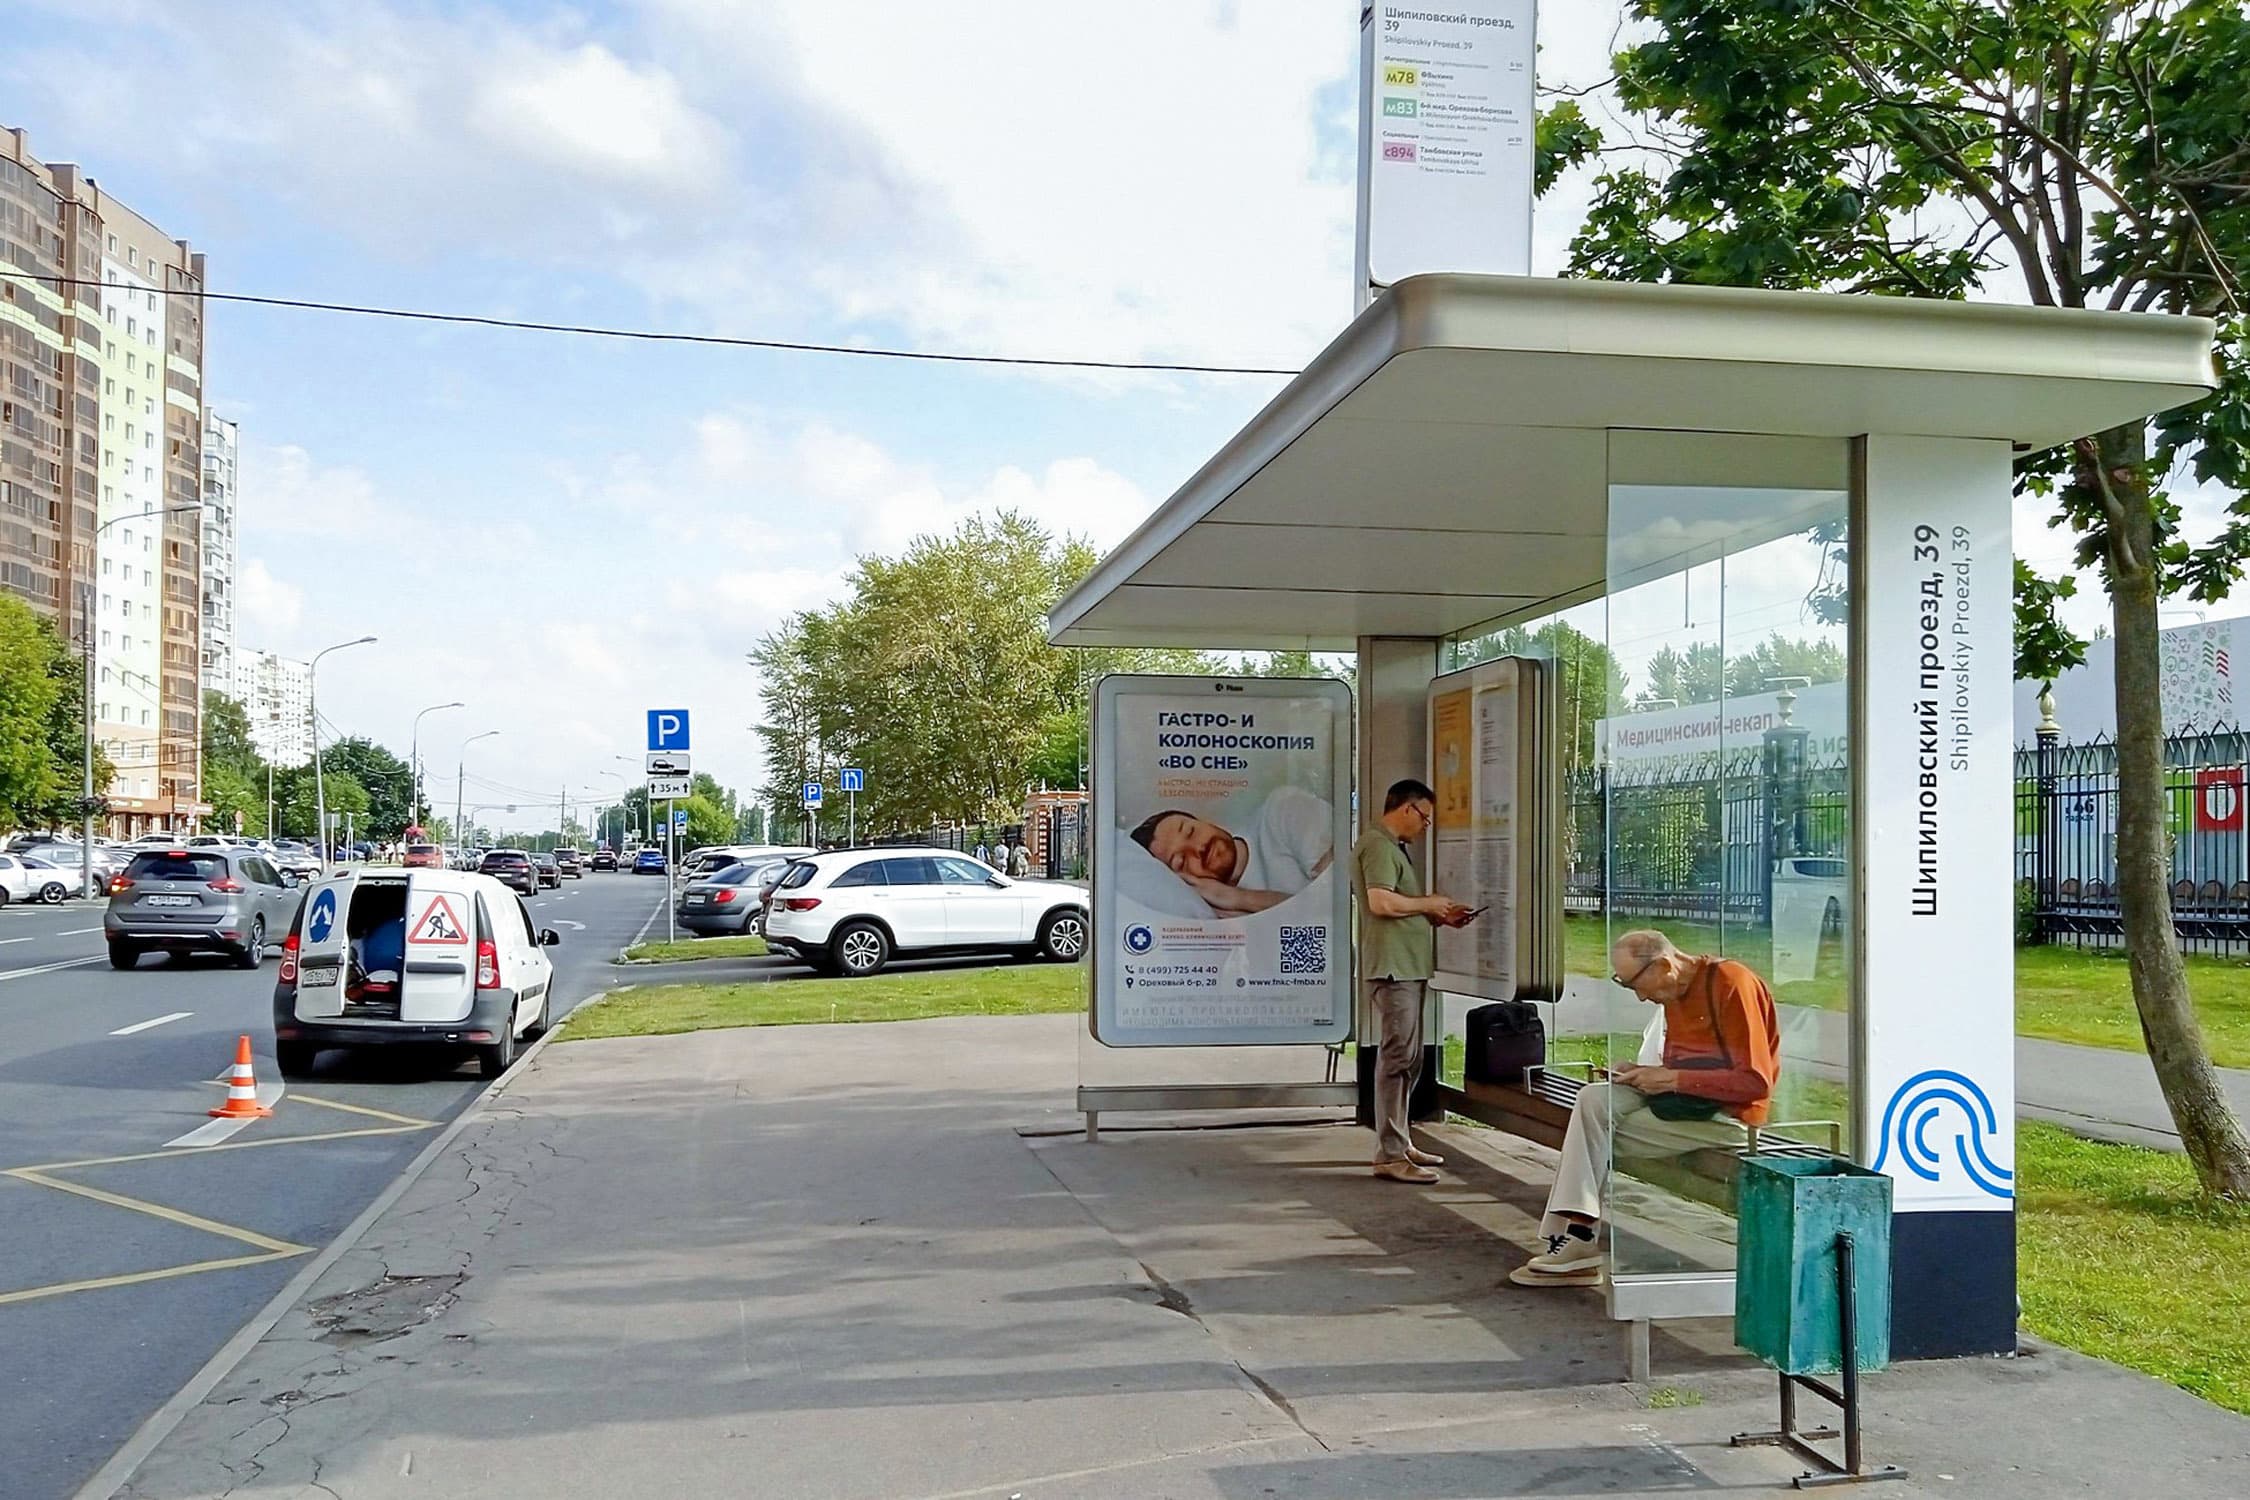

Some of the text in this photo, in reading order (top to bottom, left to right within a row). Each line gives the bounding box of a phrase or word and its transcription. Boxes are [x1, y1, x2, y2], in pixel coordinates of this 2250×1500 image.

[1384, 7, 1515, 30] Шипиловский проезд,
[1384, 20, 1400, 32] 39
[1384, 35, 1432, 47] Shipilovskiy
[1463, 42, 1473, 50] 39
[1384, 148, 1415, 160] с894
[1950, 526, 1973, 771] Shipilovskiy Proezd, 39
[1158, 712, 1254, 728] ГАСТРО- И
[1912, 524, 1944, 917] Шипиловский проезд, 39
[658, 715, 681, 746] P
[1617, 715, 1721, 749] Медицинский
[1158, 734, 1315, 750] КОЛОНОСКОПИЯ
[1159, 755, 1249, 770] «ВО СНЕ»
[659, 784, 671, 793] 35
[809, 786, 818, 799] P
[678, 812, 685, 822] P
[1146, 966, 1172, 975] (499)
[1174, 966, 1191, 974] 725
[1192, 966, 1204, 974] 44
[1205, 966, 1218, 974] 40
[1138, 978, 1185, 987] Ореховый
[1205, 978, 1217, 987] 28
